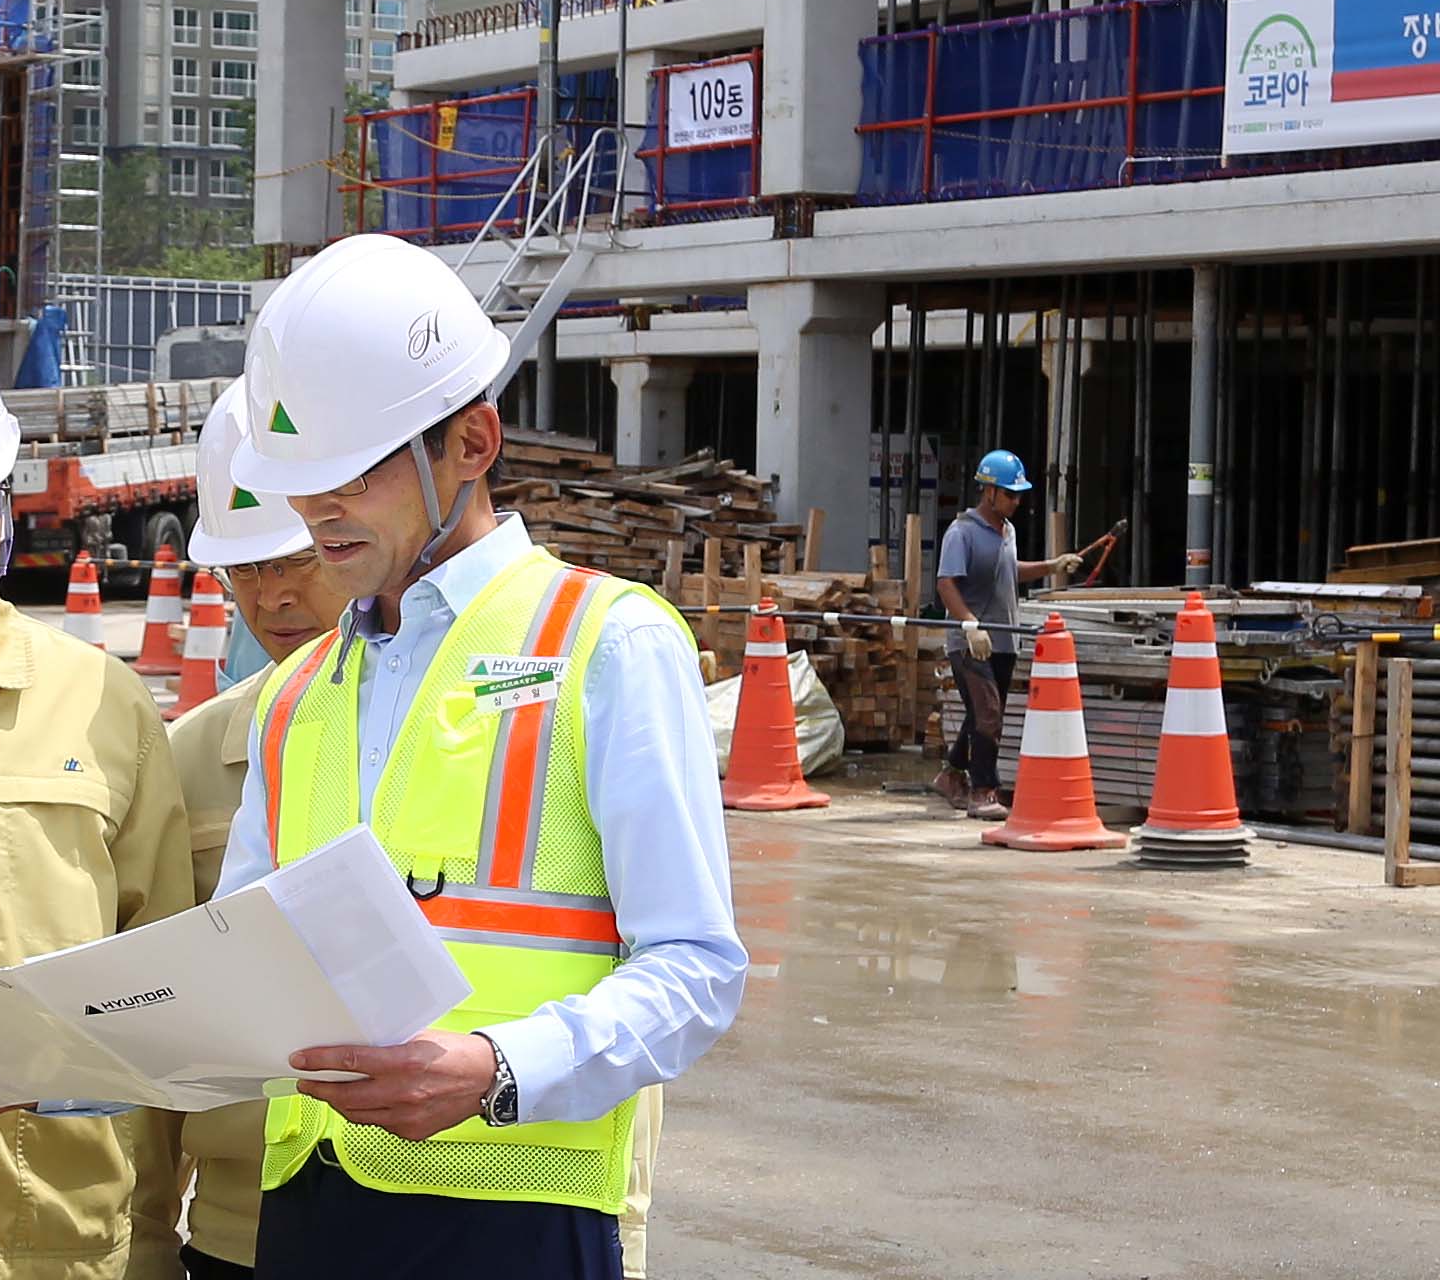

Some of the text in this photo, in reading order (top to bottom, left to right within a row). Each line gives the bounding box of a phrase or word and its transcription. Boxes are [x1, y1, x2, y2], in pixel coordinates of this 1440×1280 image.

[1250, 42, 1305, 70] 조심조심
[688, 78, 744, 122] 109동
[1243, 70, 1309, 108] 코리아
[492, 660, 564, 673] HYUNDAI
[101, 986, 174, 1010] HYUNDAI
